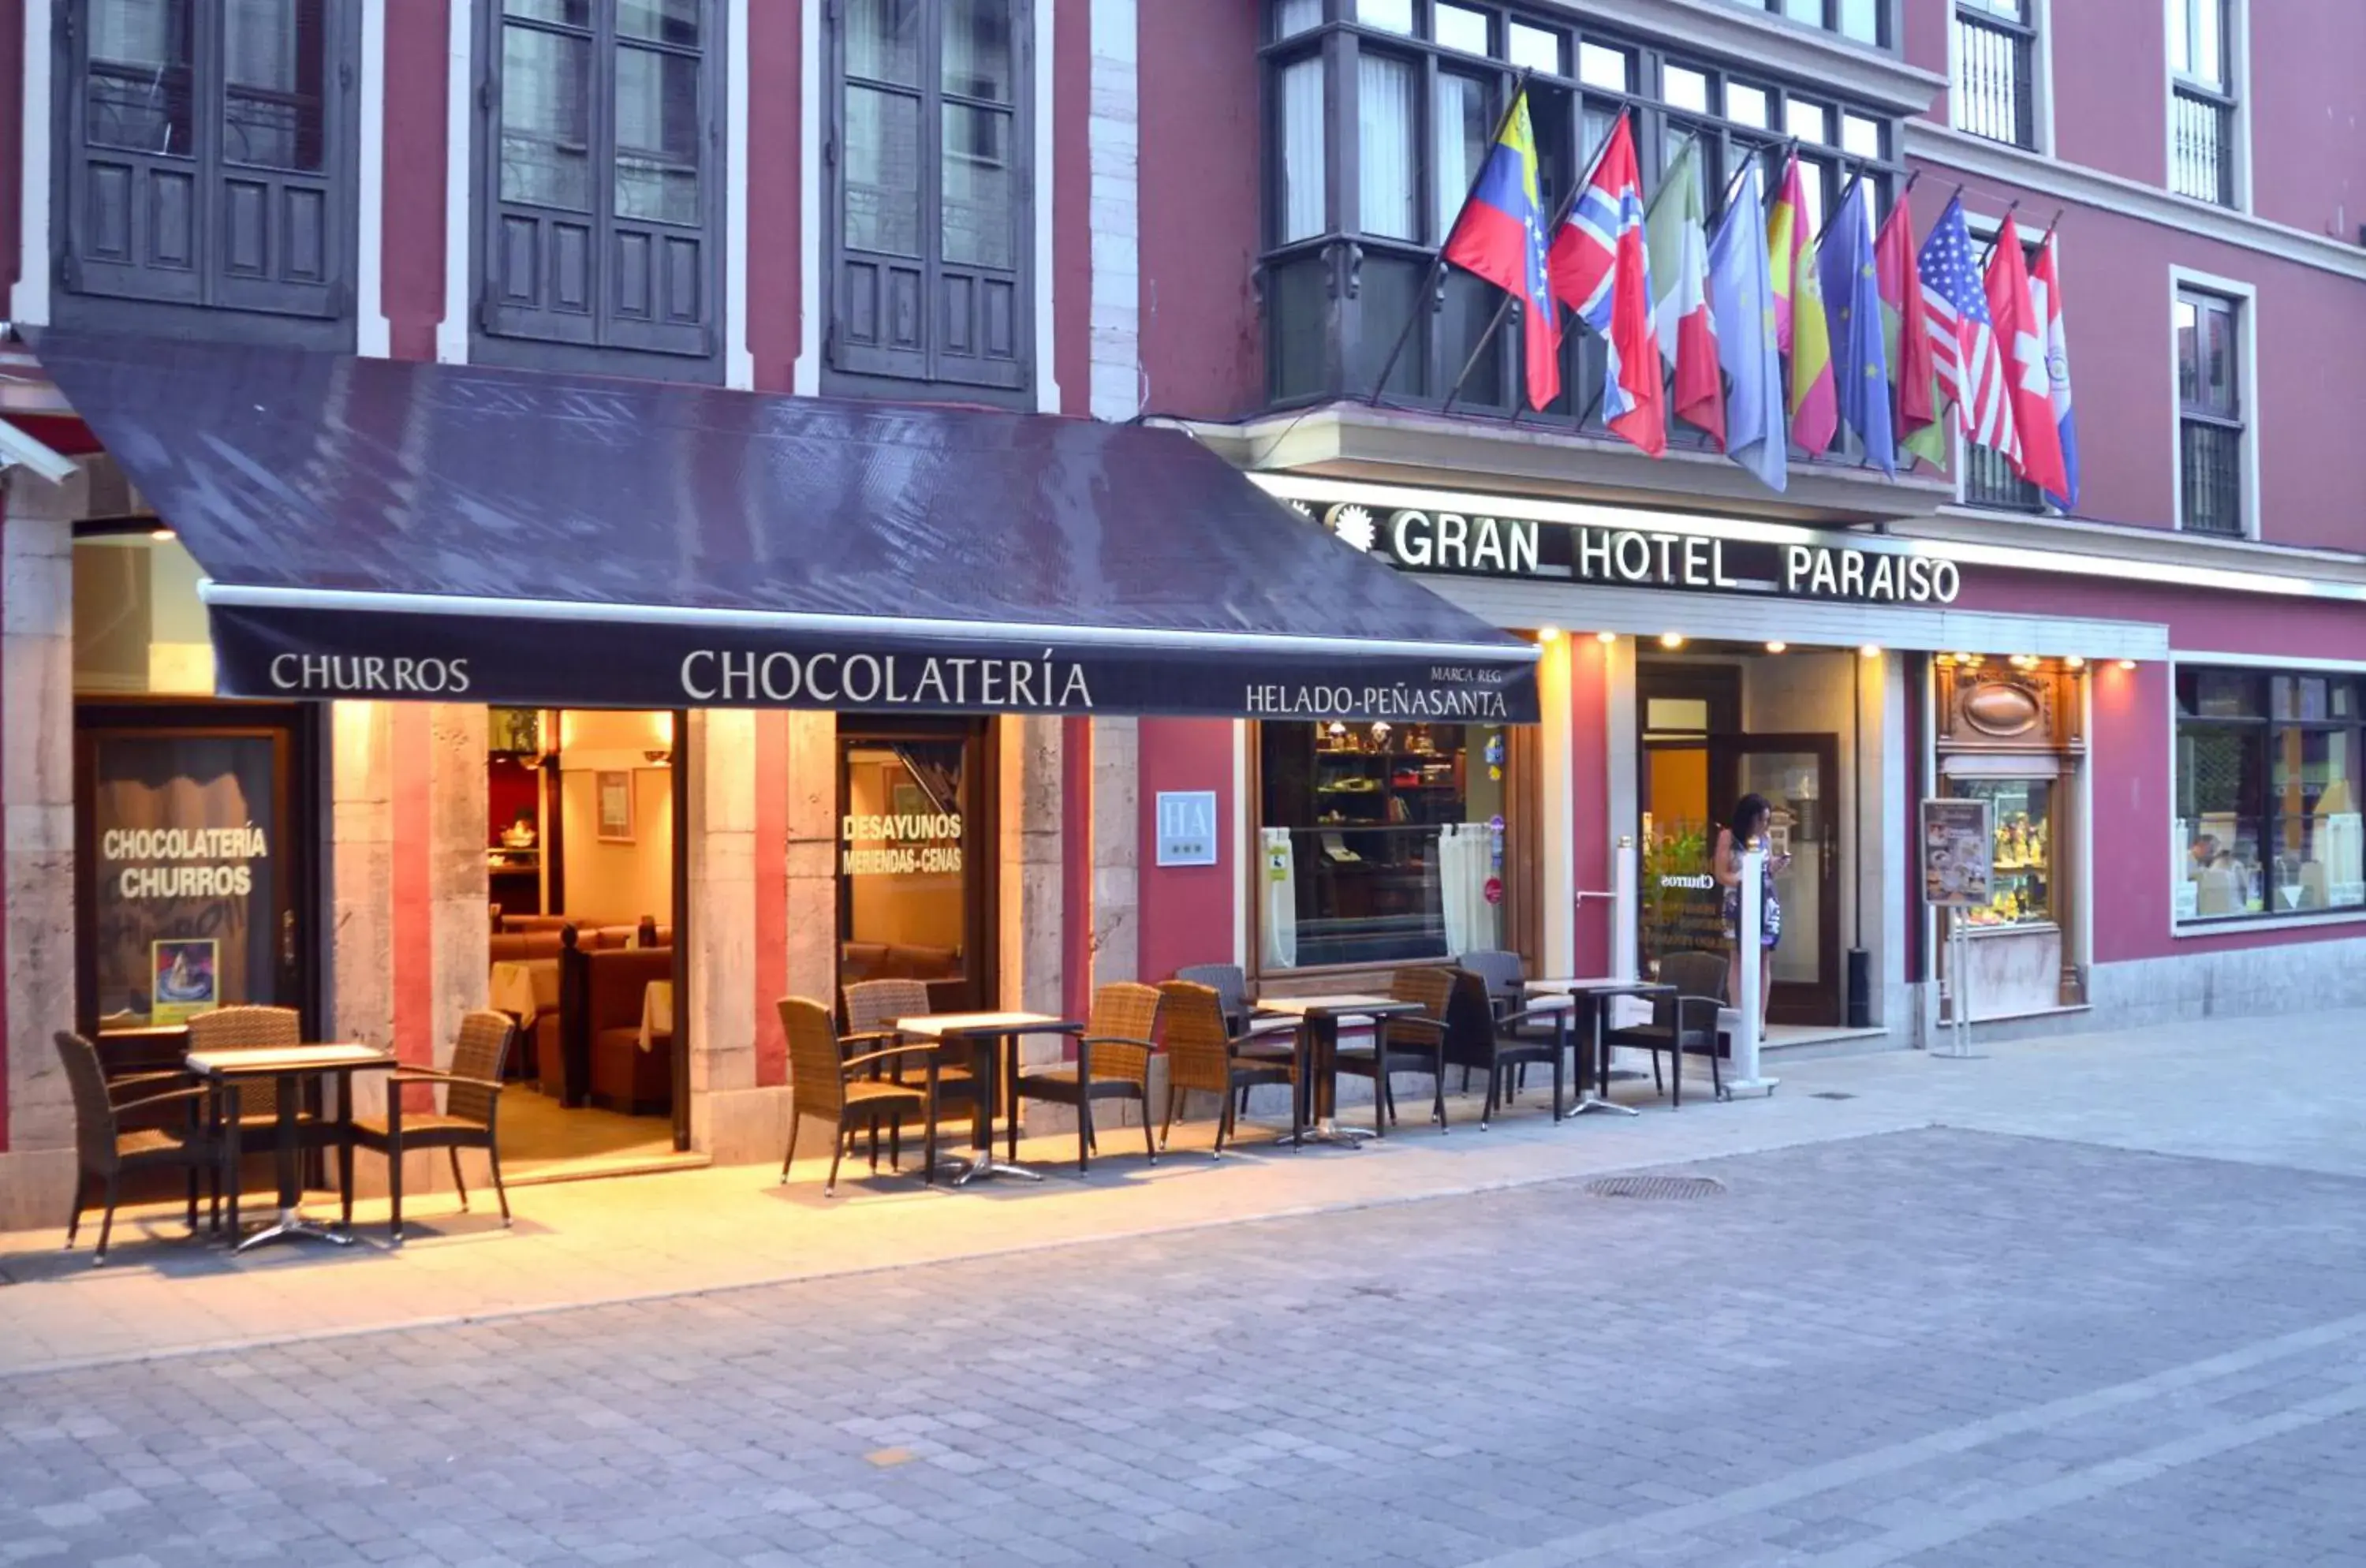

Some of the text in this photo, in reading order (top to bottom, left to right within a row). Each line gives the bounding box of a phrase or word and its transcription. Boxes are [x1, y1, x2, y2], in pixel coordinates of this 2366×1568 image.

[1390, 510, 1960, 603] GRAN HOTEL PARAISO
[270, 654, 470, 693] CHURROS
[681, 648, 1093, 707] CHOCOLATERÍA
[1431, 666, 1473, 682] MARCA
[103, 819, 267, 860] CHOCOLATERÍA
[842, 814, 961, 840] DESAYUNOS
[119, 865, 252, 898] CHURROS
